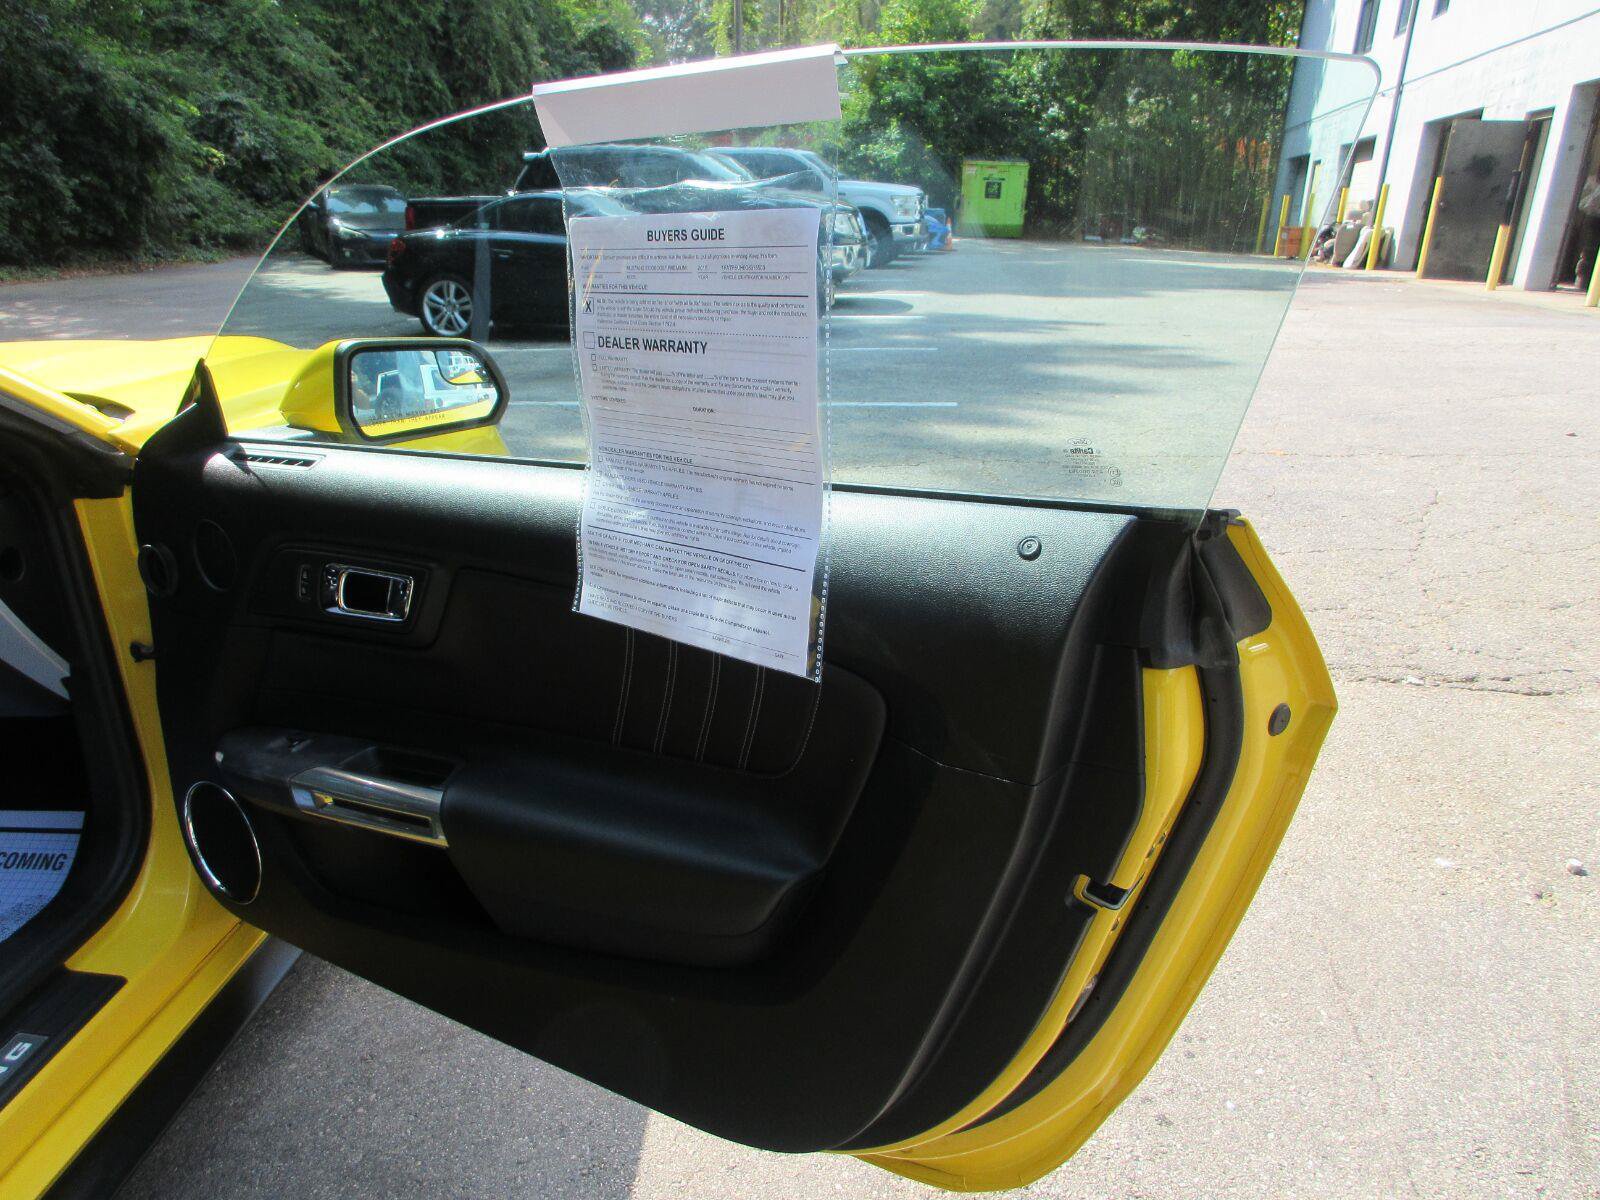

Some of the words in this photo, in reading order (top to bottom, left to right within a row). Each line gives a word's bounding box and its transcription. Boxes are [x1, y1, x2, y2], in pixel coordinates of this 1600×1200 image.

[647, 229, 688, 242] BUYERS
[691, 228, 725, 241] GUIDE
[585, 300, 592, 312] X
[598, 336, 640, 350] DEALER
[642, 338, 708, 354] WARRANTY
